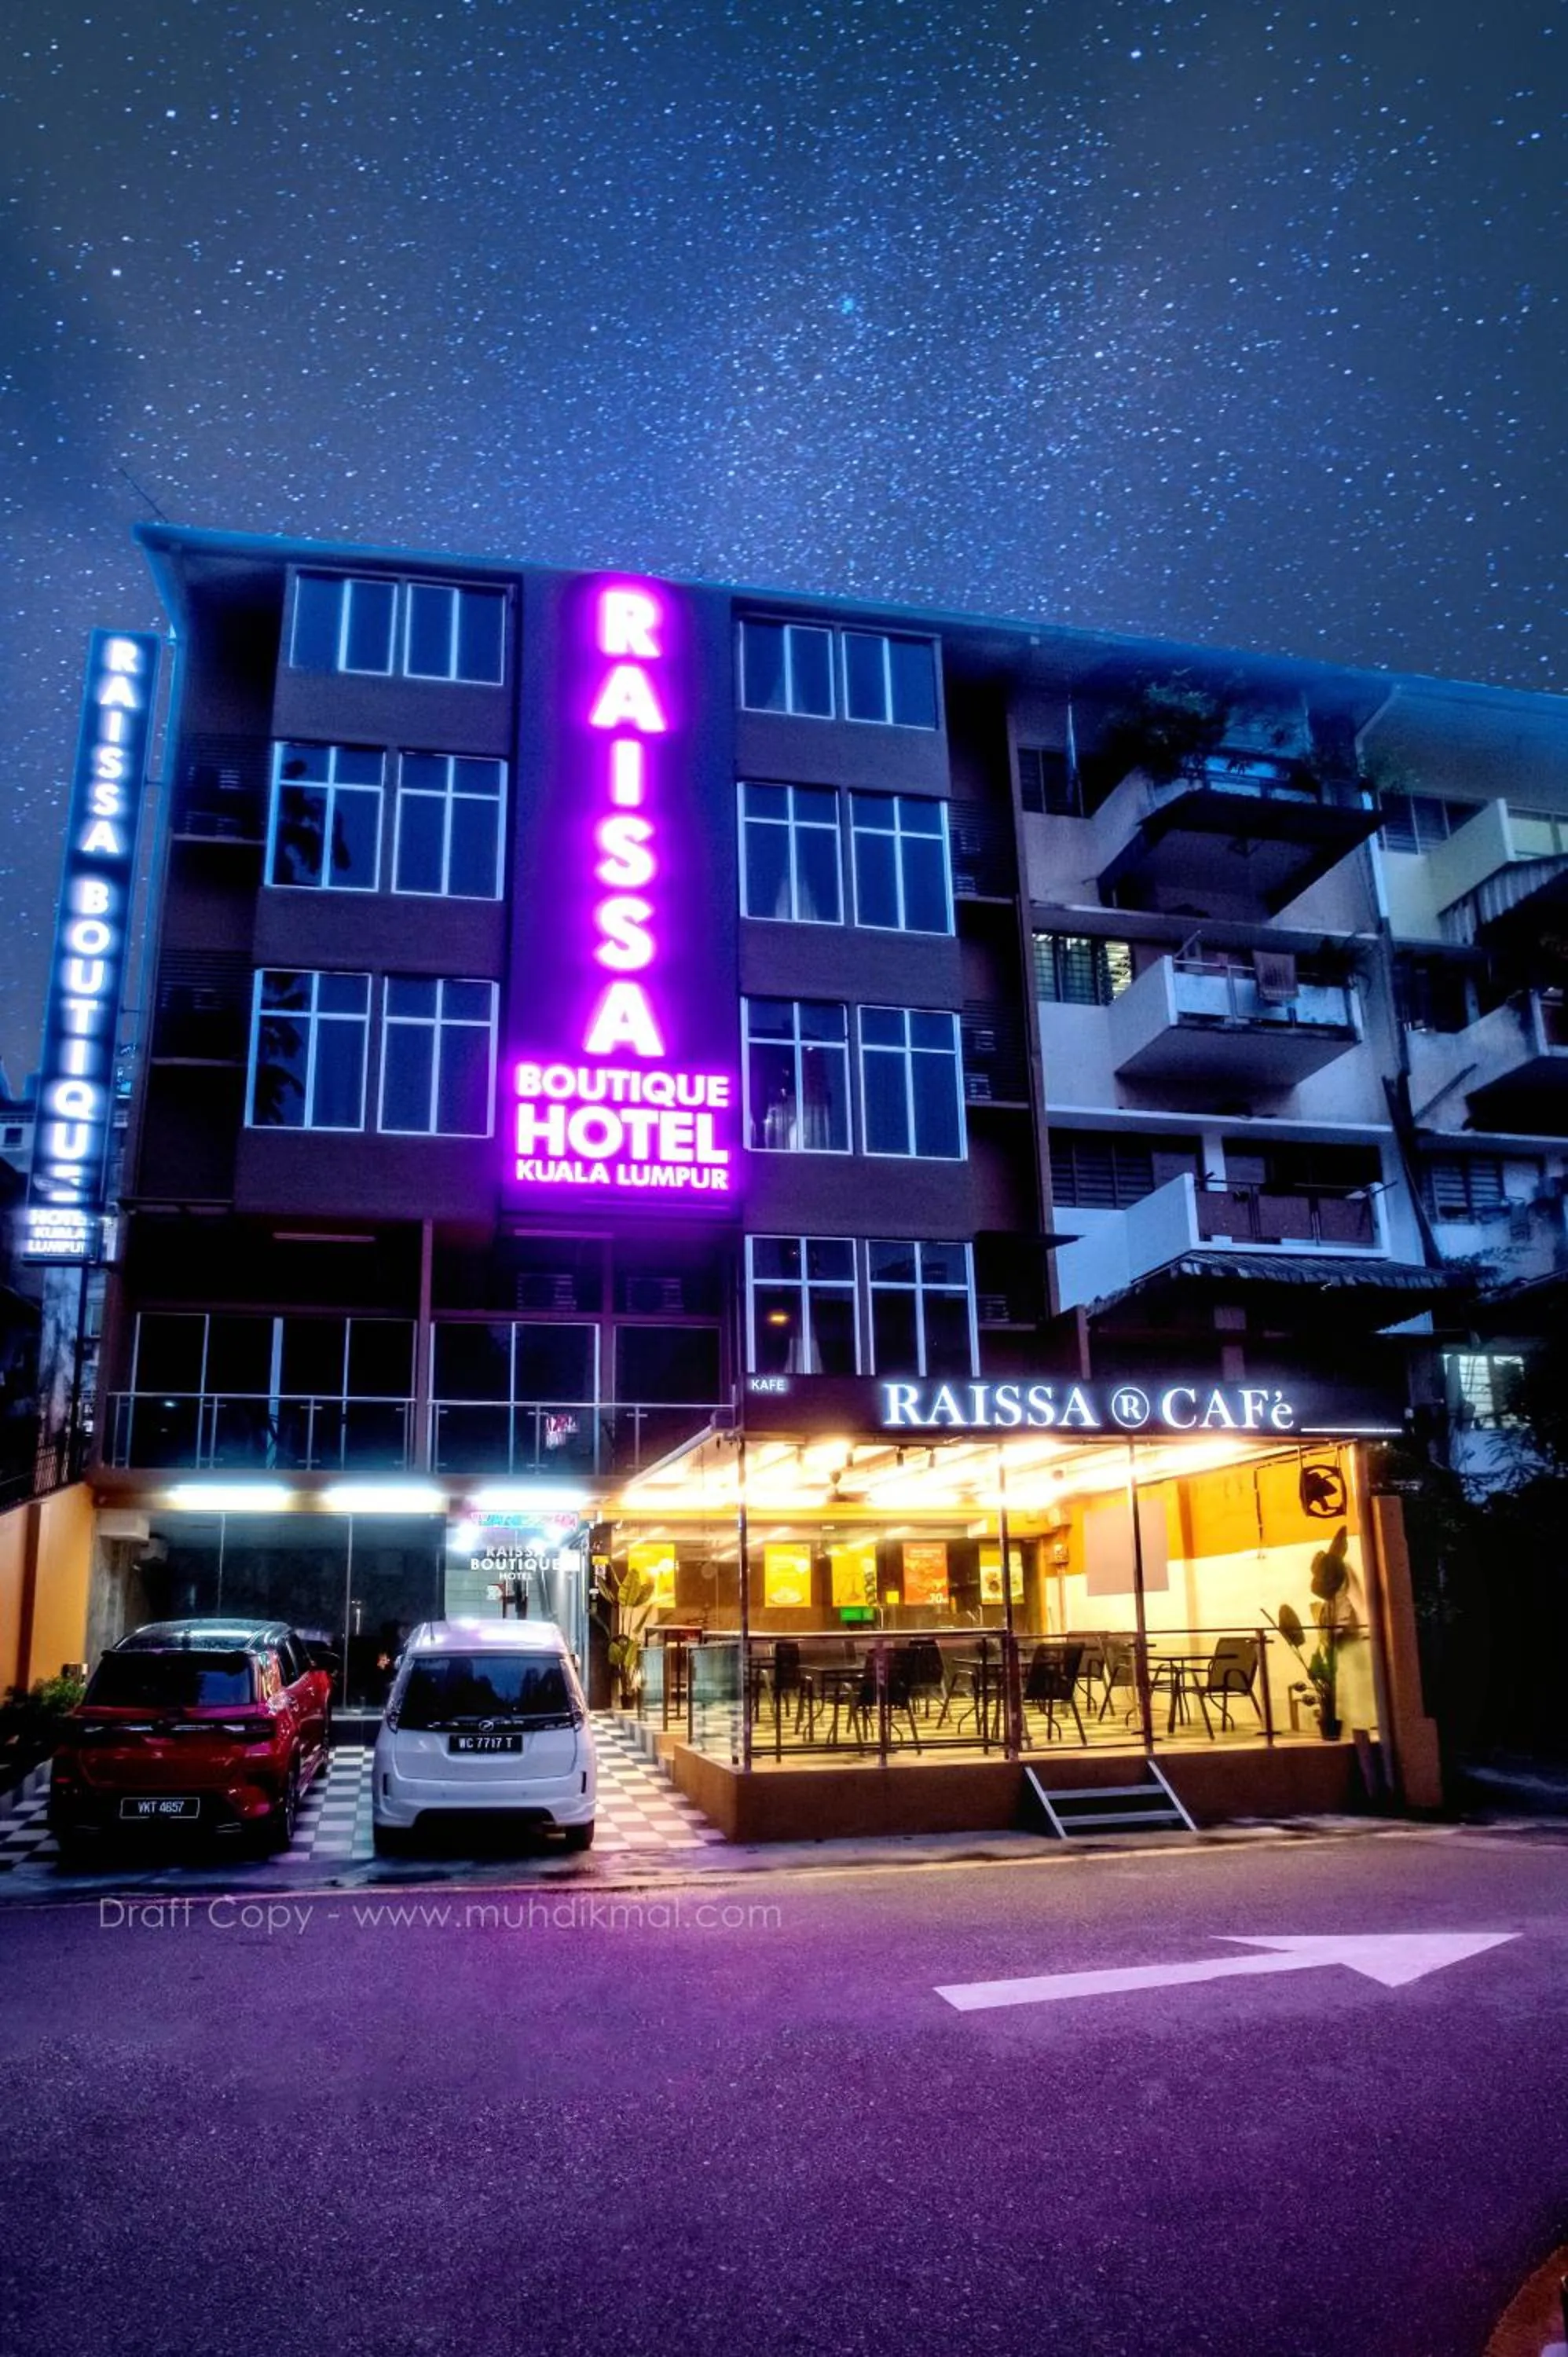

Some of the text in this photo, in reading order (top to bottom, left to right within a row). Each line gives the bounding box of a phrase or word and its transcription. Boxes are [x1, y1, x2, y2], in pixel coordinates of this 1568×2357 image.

[81, 638, 138, 854] RAISSA
[583, 589, 666, 1058] RAISSA
[516, 1064, 730, 1108] BOUTIQUE
[516, 1102, 729, 1164] HOTEL
[515, 1159, 729, 1190] KUALA LUMPUR
[751, 1379, 785, 1391] KAFE
[882, 1383, 1101, 1427] RAISSA
[471, 1557, 561, 1571] BOUTIQUE
[485, 1545, 547, 1558] RAISSA
[499, 1572, 533, 1581] HOTEL
[458, 1737, 513, 1748] WC 7717 T
